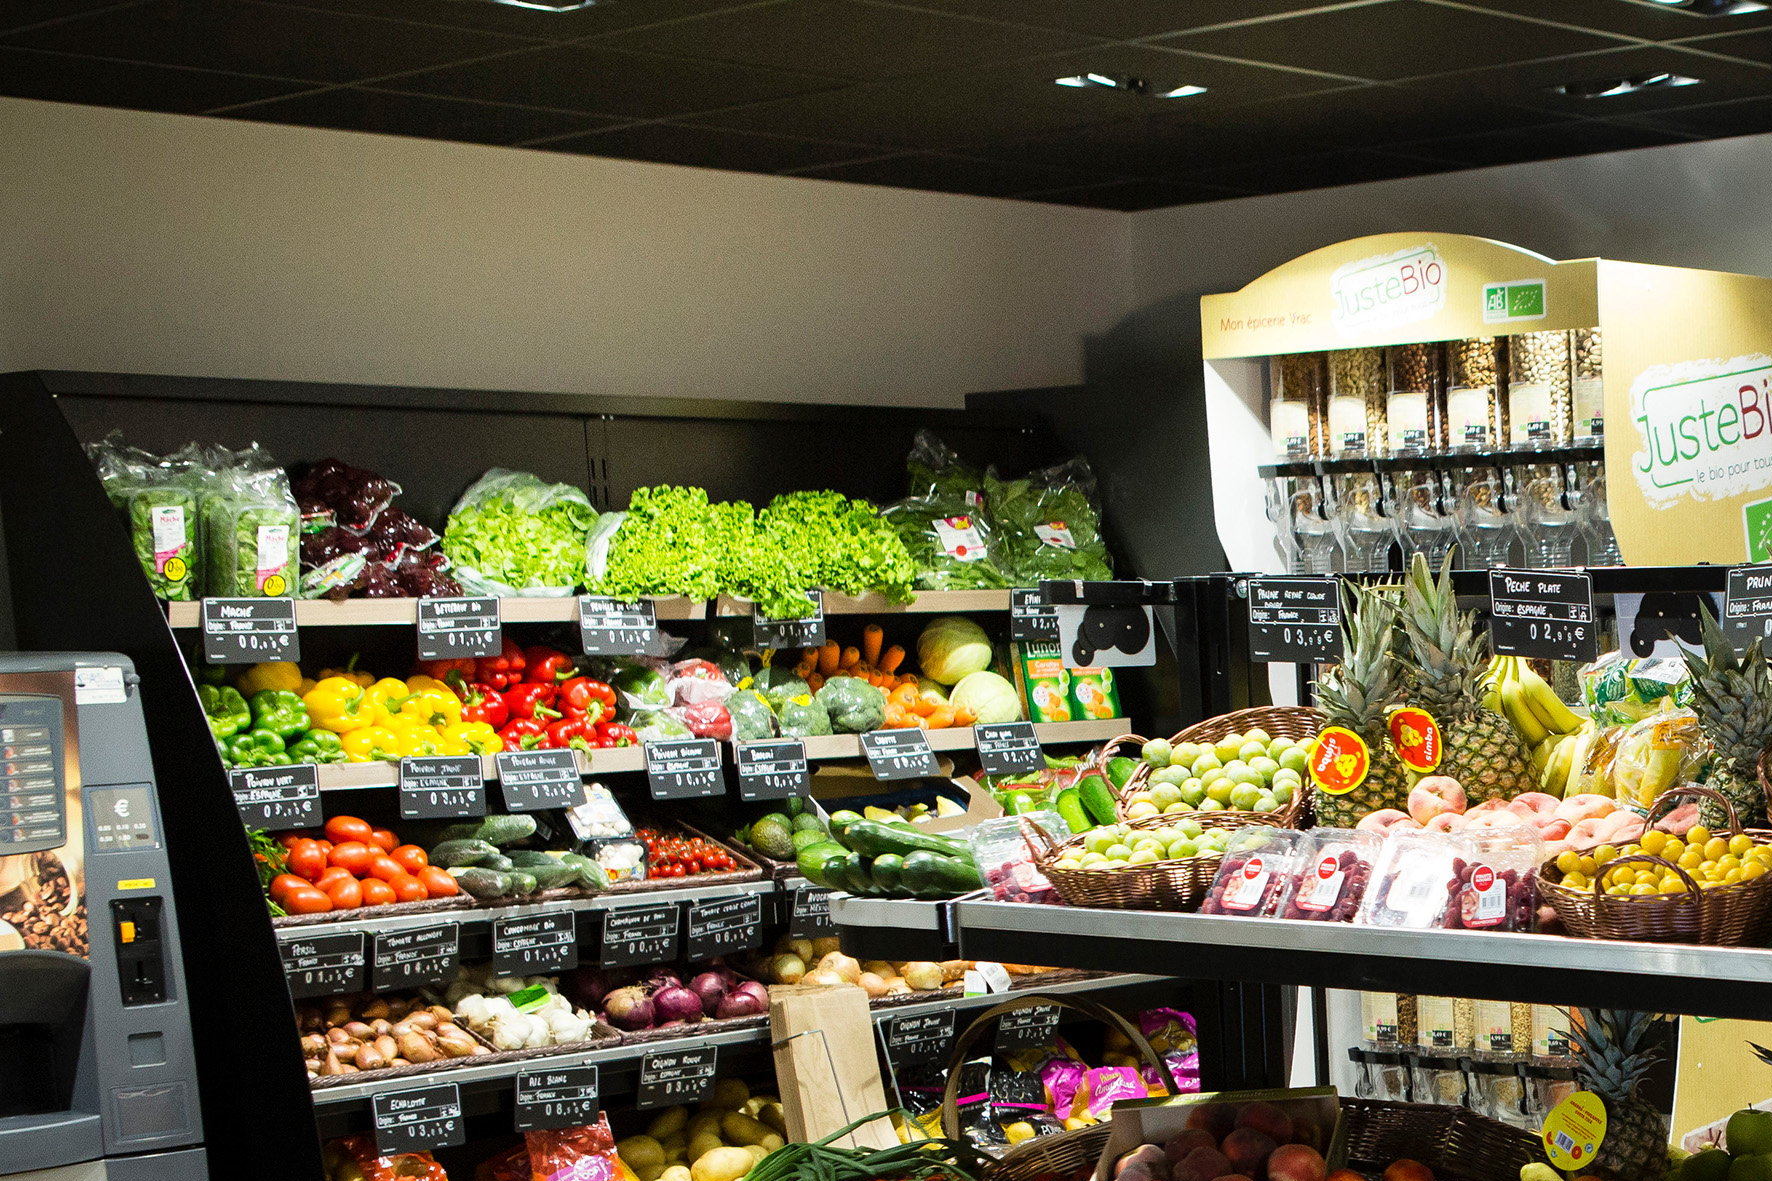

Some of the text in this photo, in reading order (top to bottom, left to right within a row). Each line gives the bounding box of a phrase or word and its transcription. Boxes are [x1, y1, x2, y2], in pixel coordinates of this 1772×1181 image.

[1220, 312, 1312, 332] Mon épicerie Vrac
[1696, 468, 1705, 483] le
[1709, 465, 1725, 481] bio
[1728, 462, 1751, 480] pour
[1505, 577, 1561, 594] PECHE PLATE
[1495, 602, 1547, 616] Origine: ESPAGNE
[1730, 602, 1750, 615] Origine:
[1424, 726, 1434, 763] simba
[1316, 736, 1337, 774] simba
